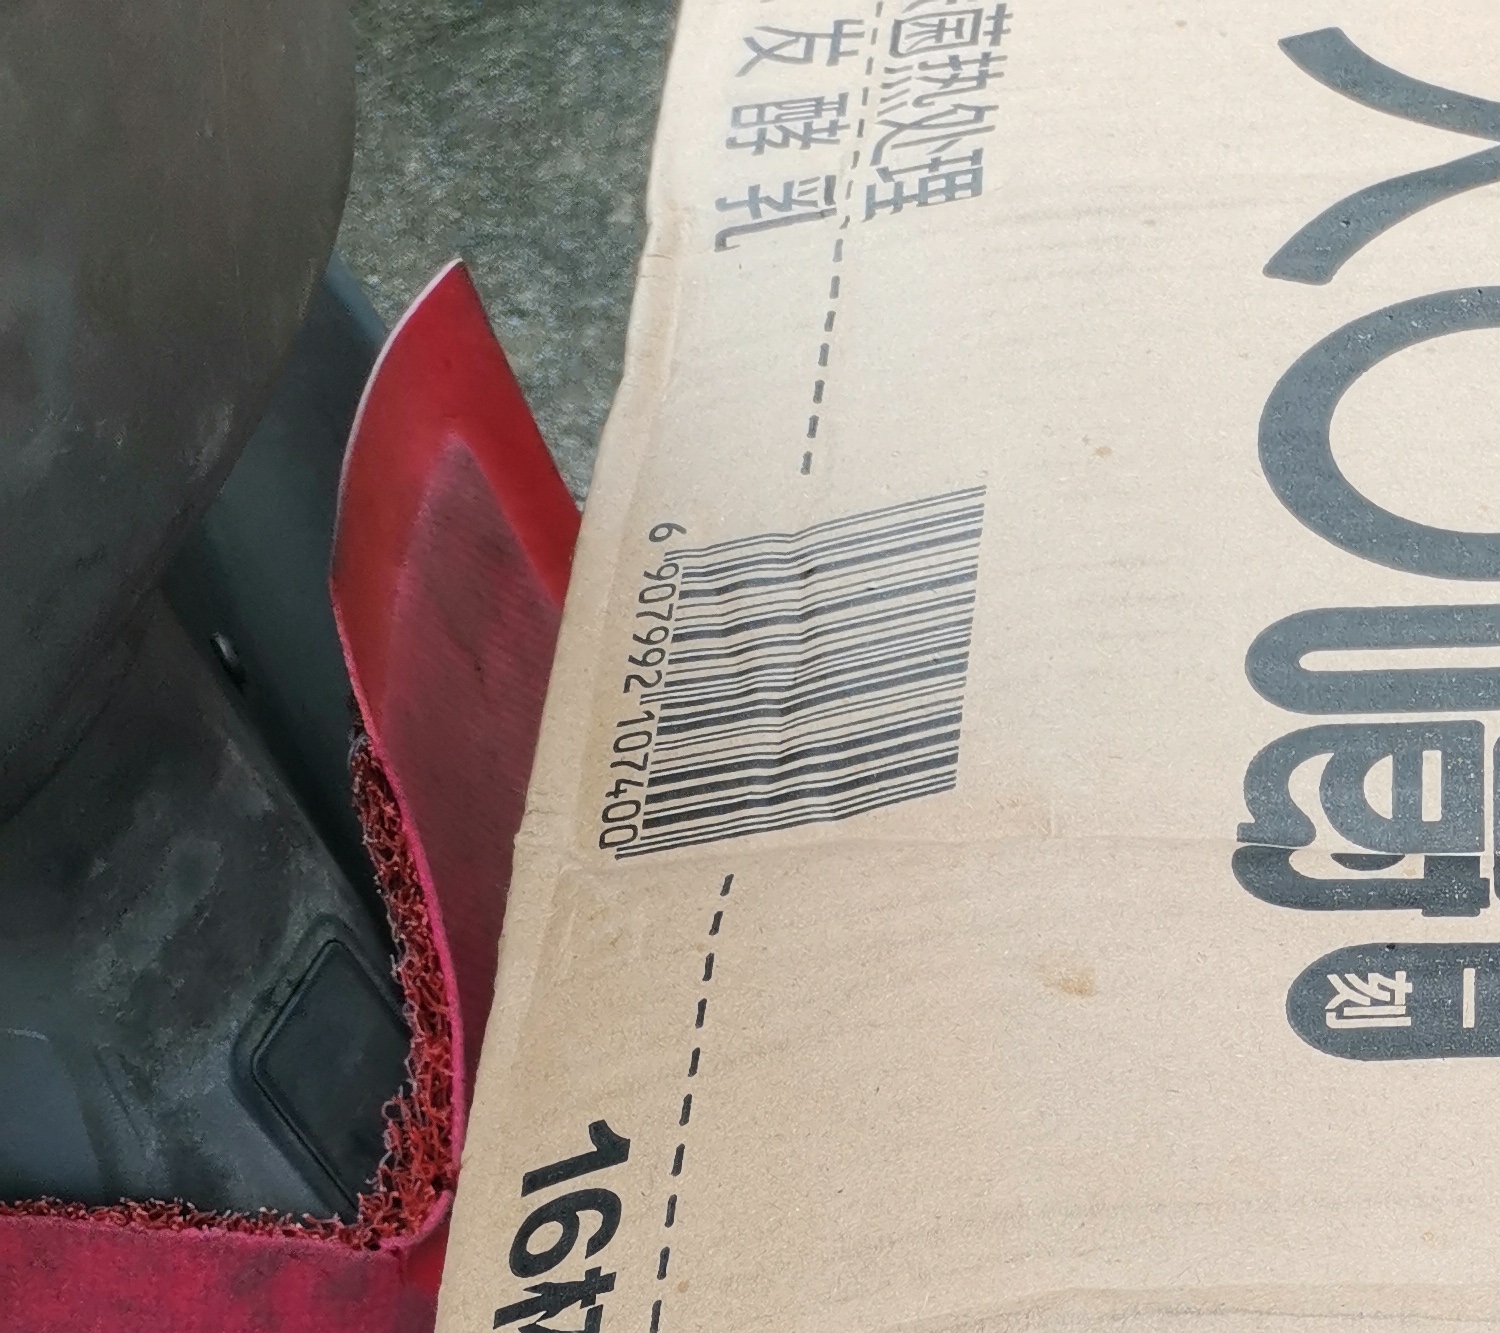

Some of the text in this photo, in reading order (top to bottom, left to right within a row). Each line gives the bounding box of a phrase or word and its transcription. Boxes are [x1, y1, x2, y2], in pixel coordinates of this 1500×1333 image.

[715, 19, 866, 253] 发酵乳
[862, 0, 1015, 223] 菌热处理
[599, 522, 688, 850] 6 907992 107400
